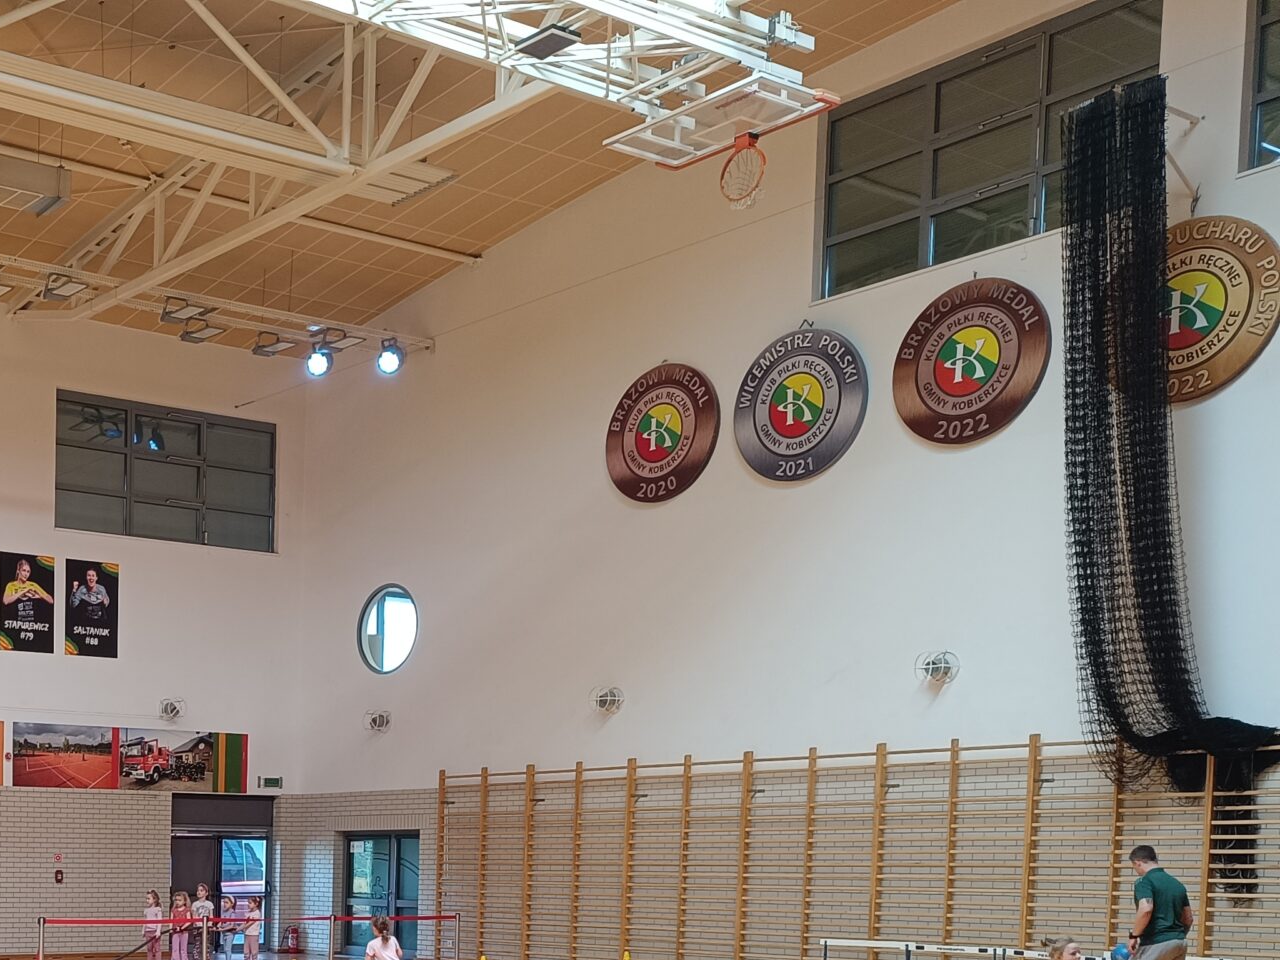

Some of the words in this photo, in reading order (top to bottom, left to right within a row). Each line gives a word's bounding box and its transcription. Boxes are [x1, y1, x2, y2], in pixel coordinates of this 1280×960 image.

[1164, 255, 1193, 277] IŁKI
[1197, 254, 1243, 288] RĘCZNEJ
[1247, 255, 1279, 336] POLSKI
[901, 284, 983, 360] BRĄZOWY
[988, 284, 1039, 331] MEDAL
[924, 333, 945, 361] KLUB
[947, 312, 974, 332] PIŁKI
[978, 311, 1013, 343] RĘCZNEJ
[1167, 310, 1240, 368] KOBIERZYCE
[739, 333, 813, 408] WICEMISTRZ
[819, 335, 858, 384] POLSKI
[760, 379, 777, 404] KLUB
[778, 360, 800, 377] PIŁKI
[803, 360, 834, 389] RĘCZNEJ
[923, 382, 949, 409] GMINY
[952, 363, 1010, 411] KOBIERZYCE
[1167, 369, 1212, 397] 022
[611, 367, 668, 431] BRĄZOWY
[672, 368, 709, 407] MEDAL
[628, 409, 643, 433] KLUB
[644, 392, 663, 408] PIŁKI
[665, 391, 691, 418] RĘCZNEJ
[761, 424, 783, 448] GMINY
[785, 408, 833, 451] KOBIERZYCE
[934, 413, 989, 438] 2022
[628, 449, 647, 472] GMINY
[648, 434, 690, 474] KOBIERZYCE
[776, 457, 813, 476] 2021
[637, 476, 676, 497] 2020
[20, 632, 34, 640] #79
